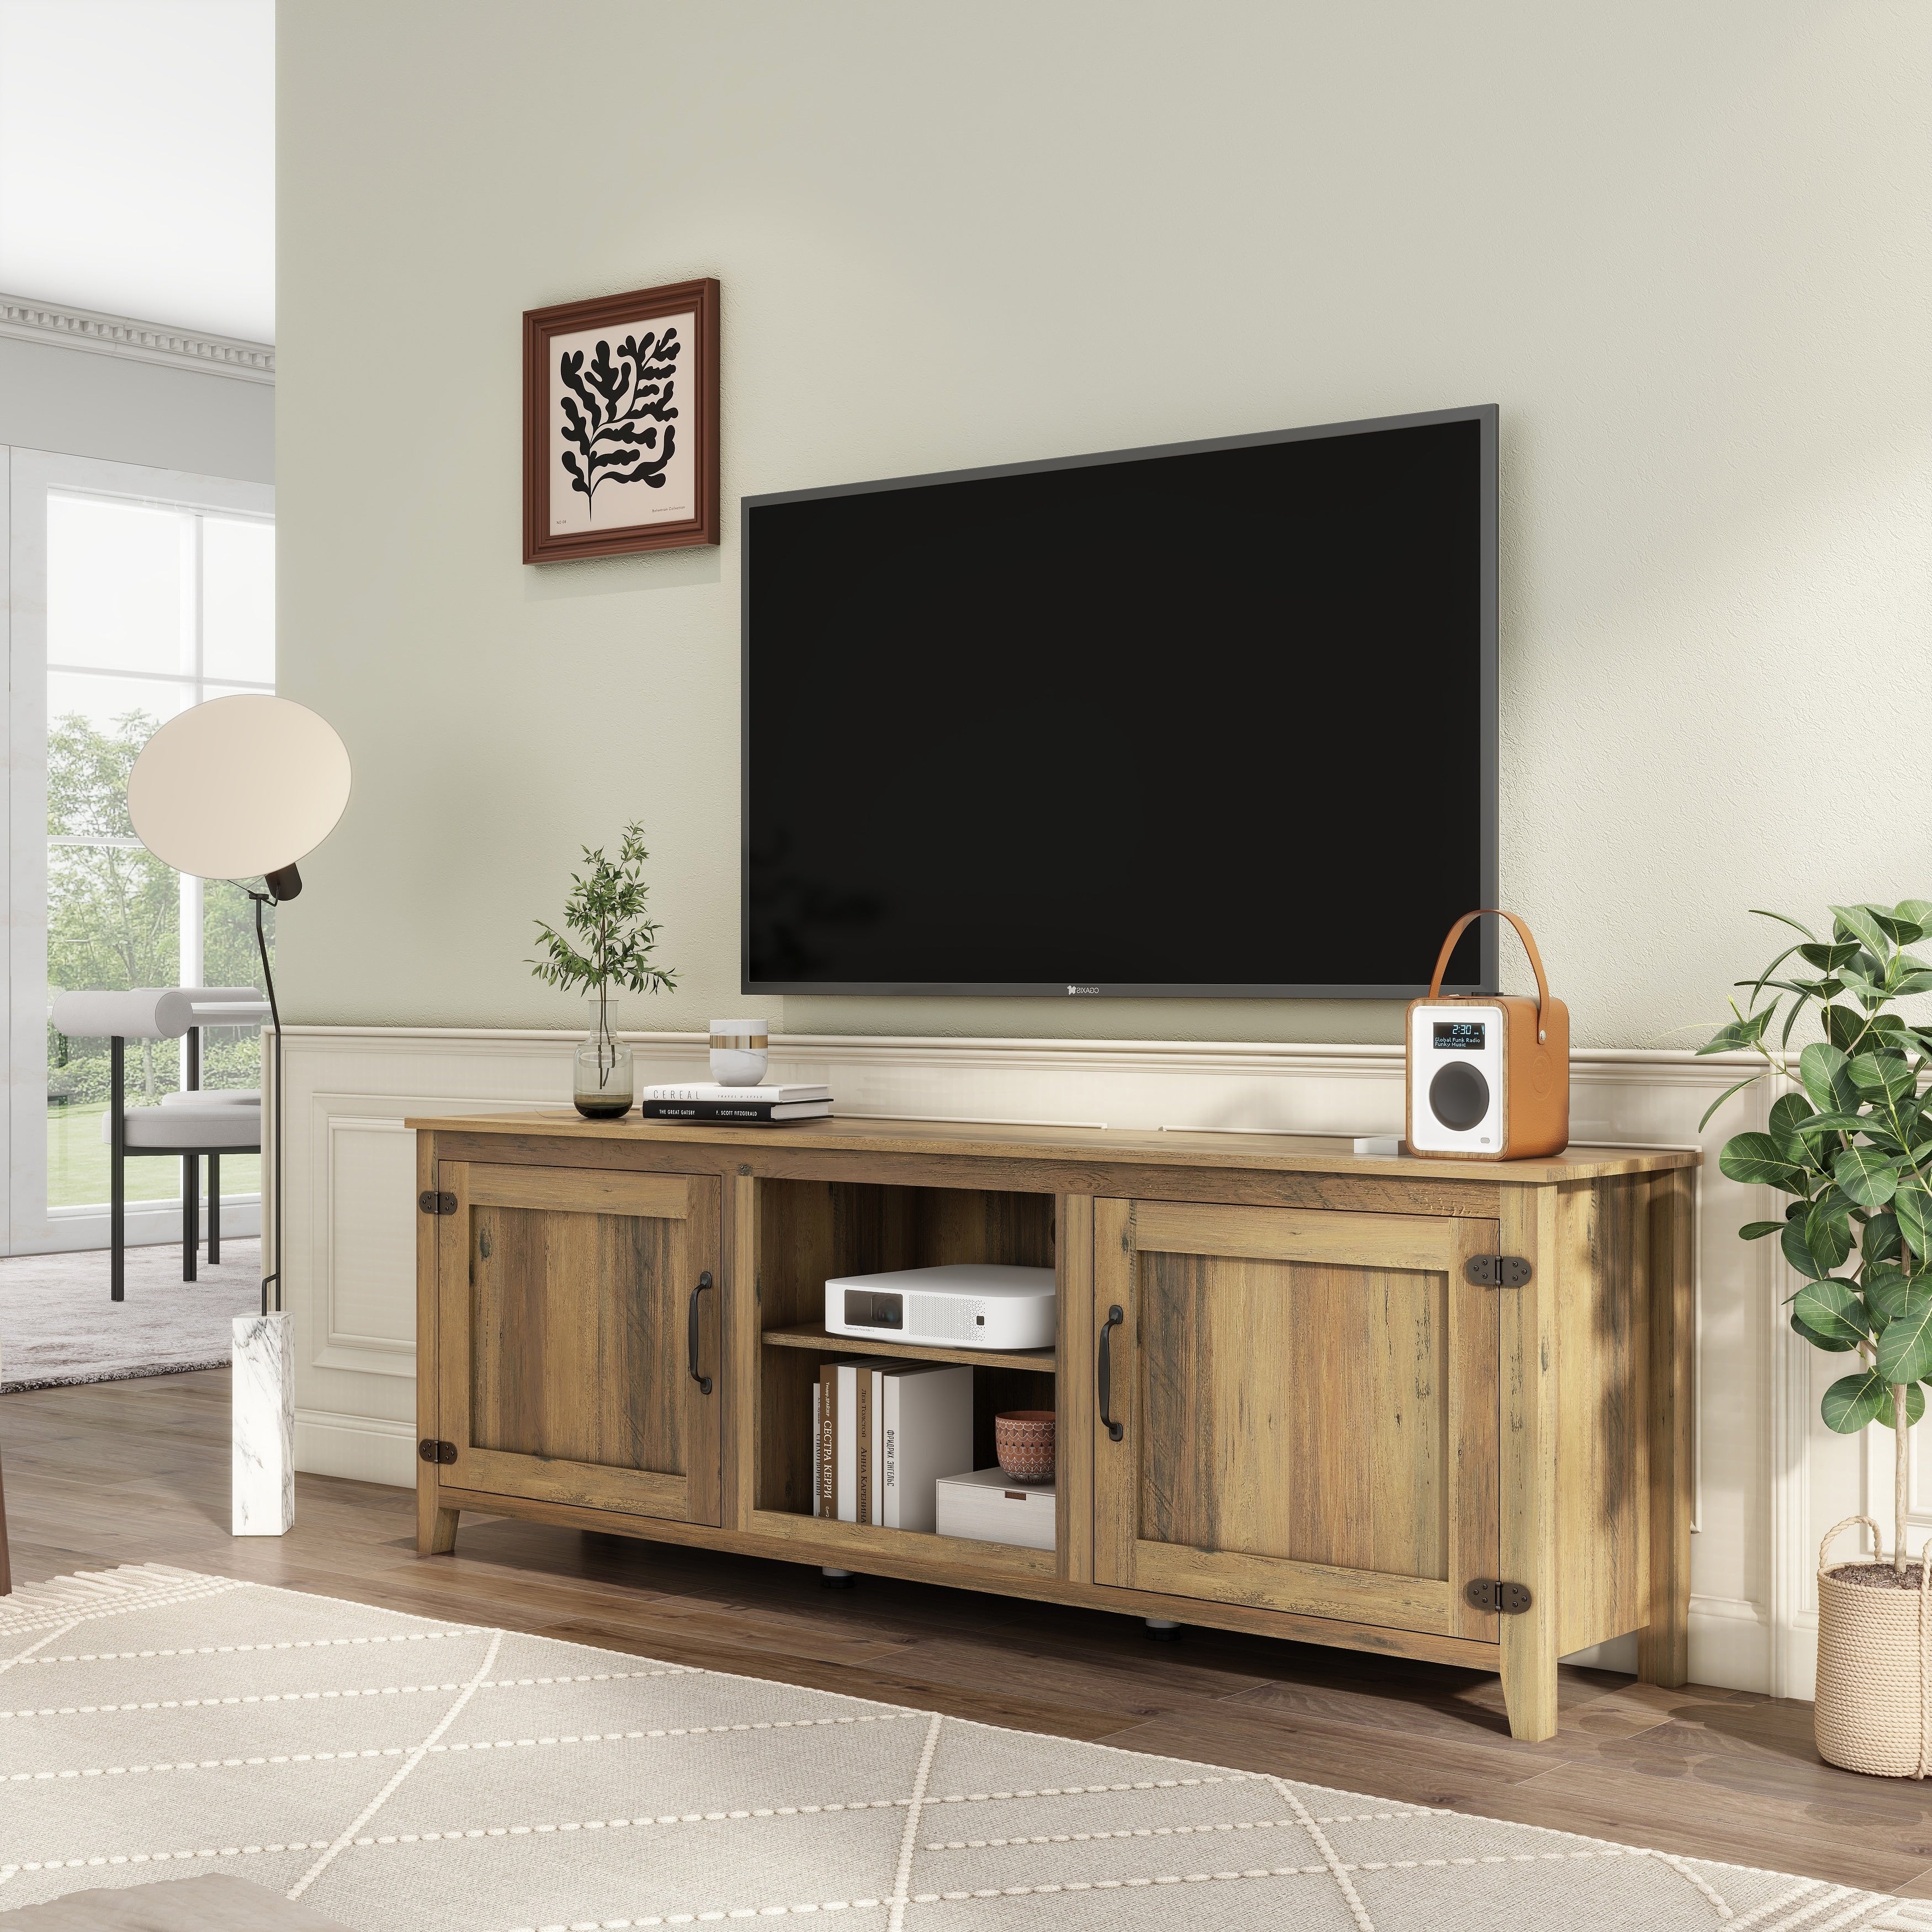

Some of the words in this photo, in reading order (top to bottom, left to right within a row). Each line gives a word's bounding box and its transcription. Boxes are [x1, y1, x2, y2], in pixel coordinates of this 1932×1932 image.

[1452, 1025, 1472, 1034] 2:30
[653, 1090, 700, 1100] CEREAL
[824, 1420, 832, 1461] СЕСТРА
[886, 1430, 895, 1458] ФРИДРИХ
[824, 1464, 832, 1499] КЕРРИ
